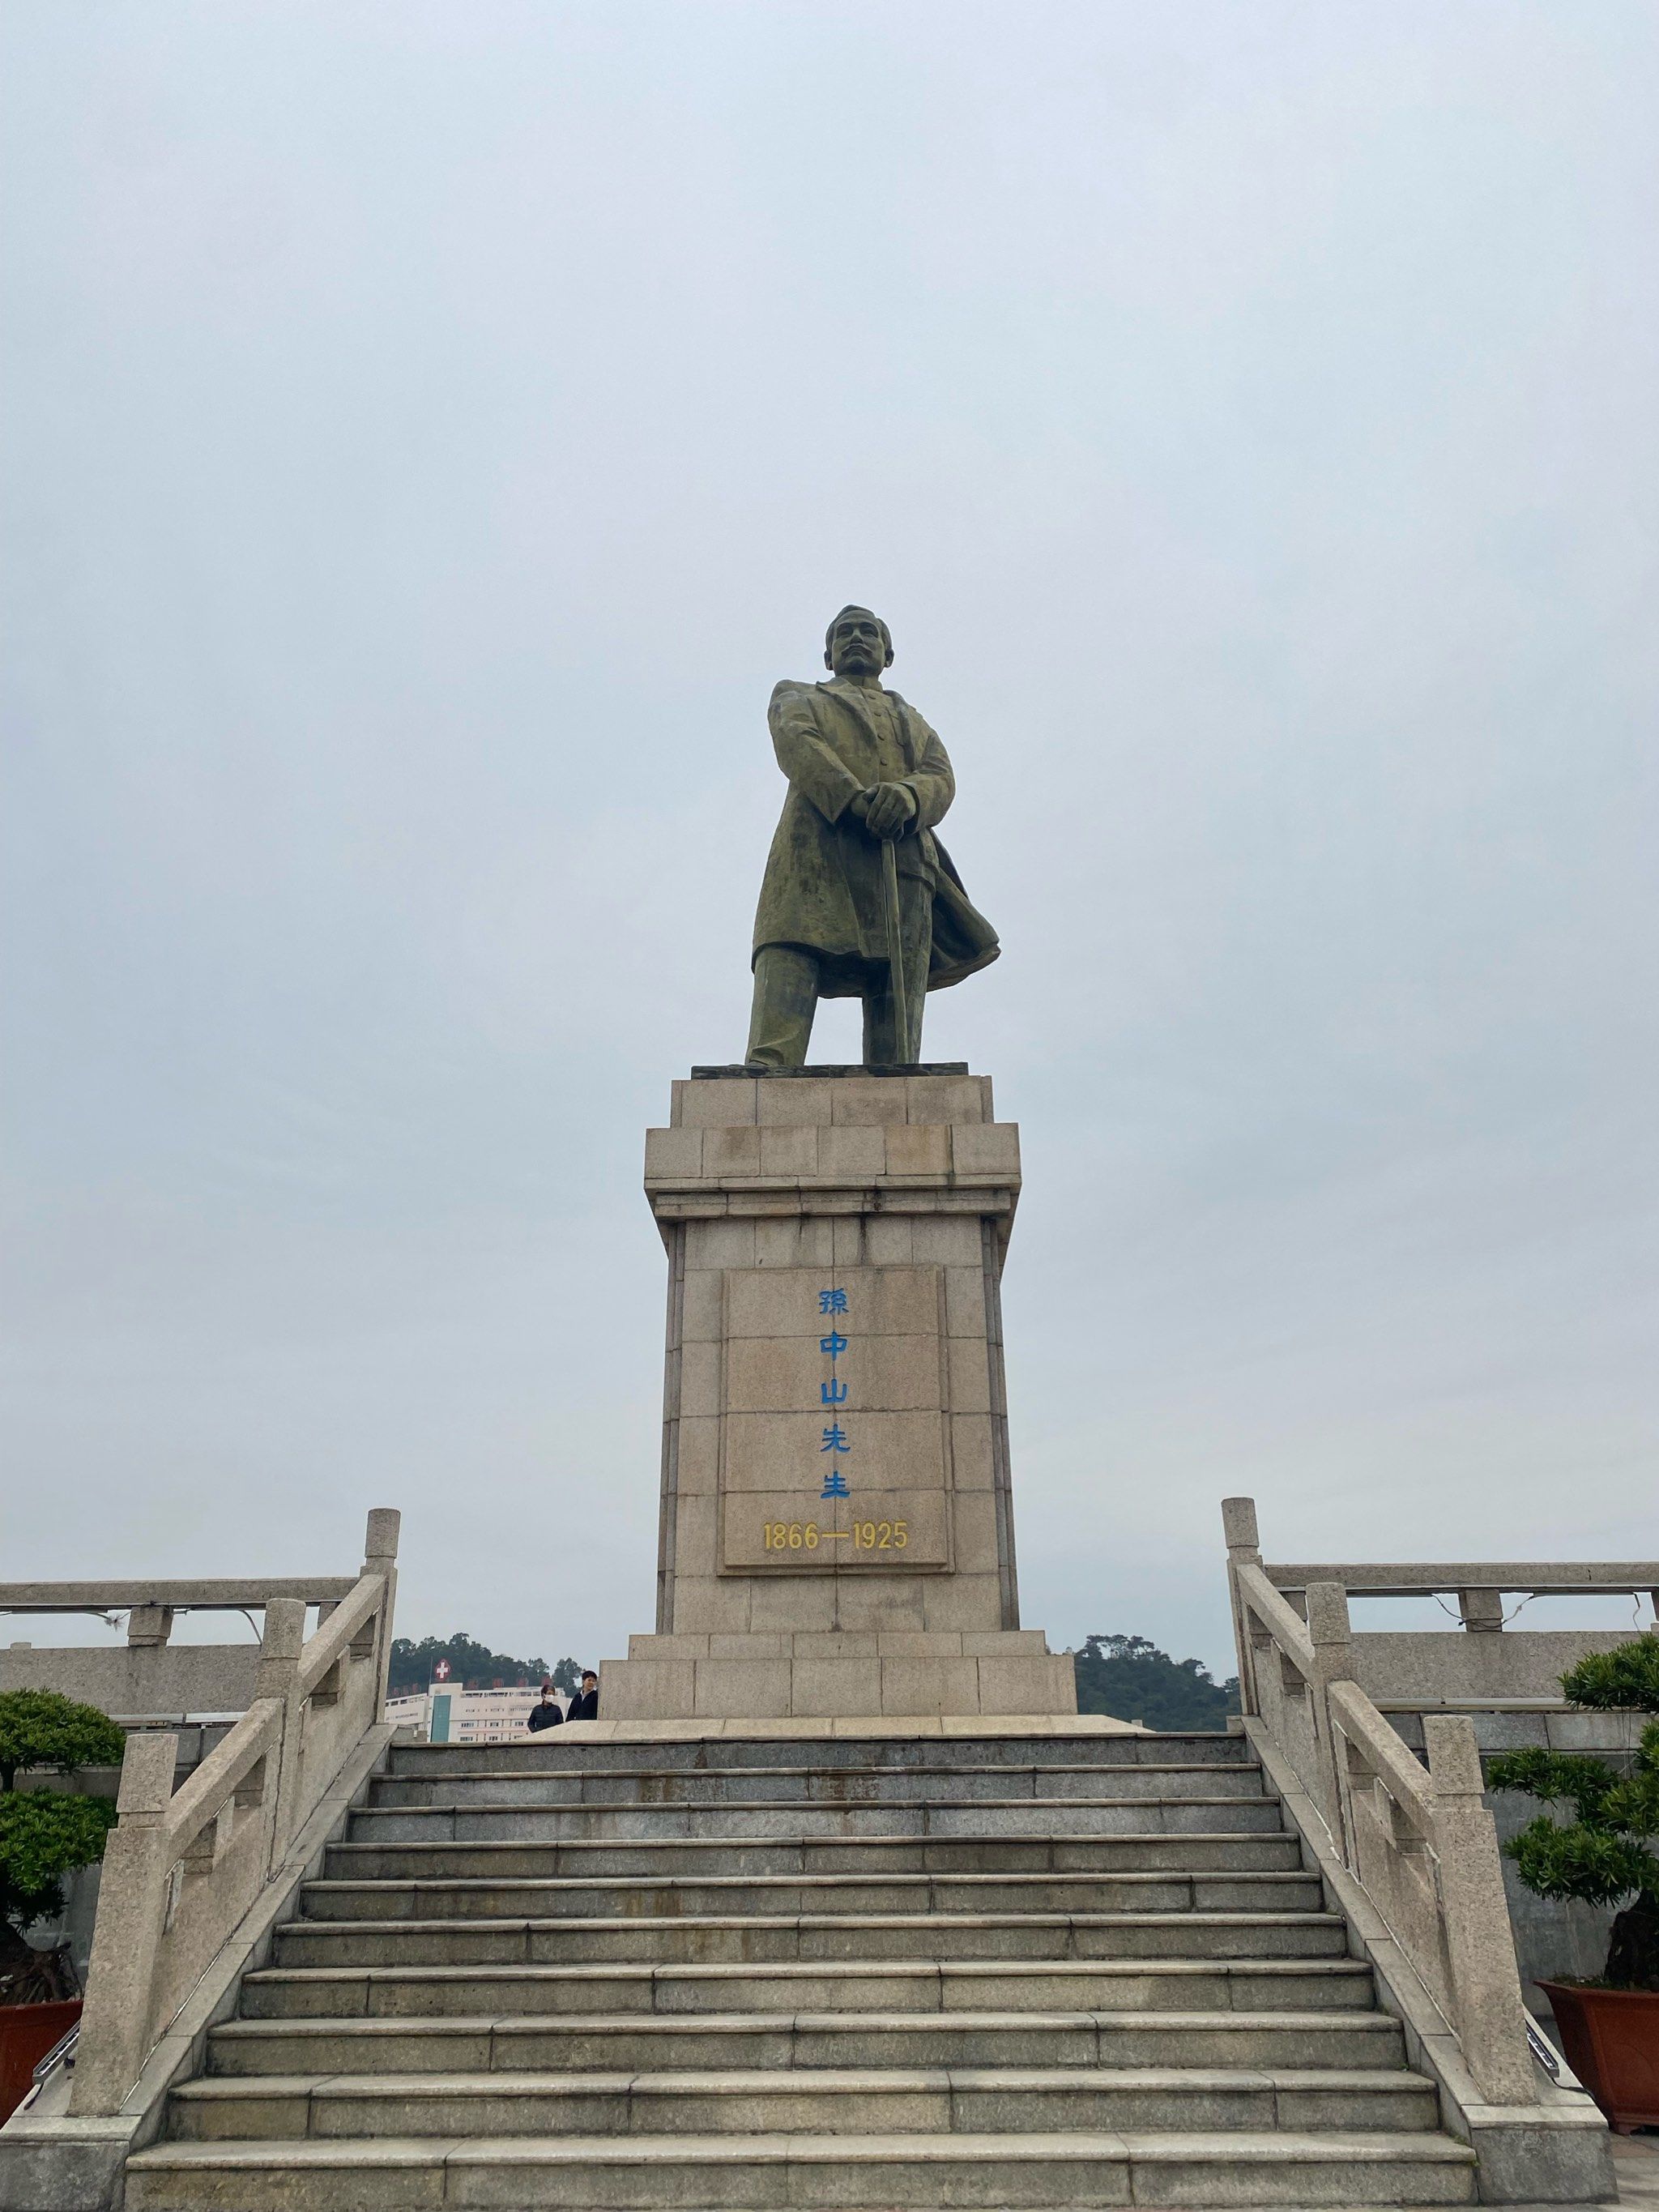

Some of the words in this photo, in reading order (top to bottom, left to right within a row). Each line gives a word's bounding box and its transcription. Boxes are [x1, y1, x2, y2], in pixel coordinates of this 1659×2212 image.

[818, 1287, 851, 1499] 孫中山先生
